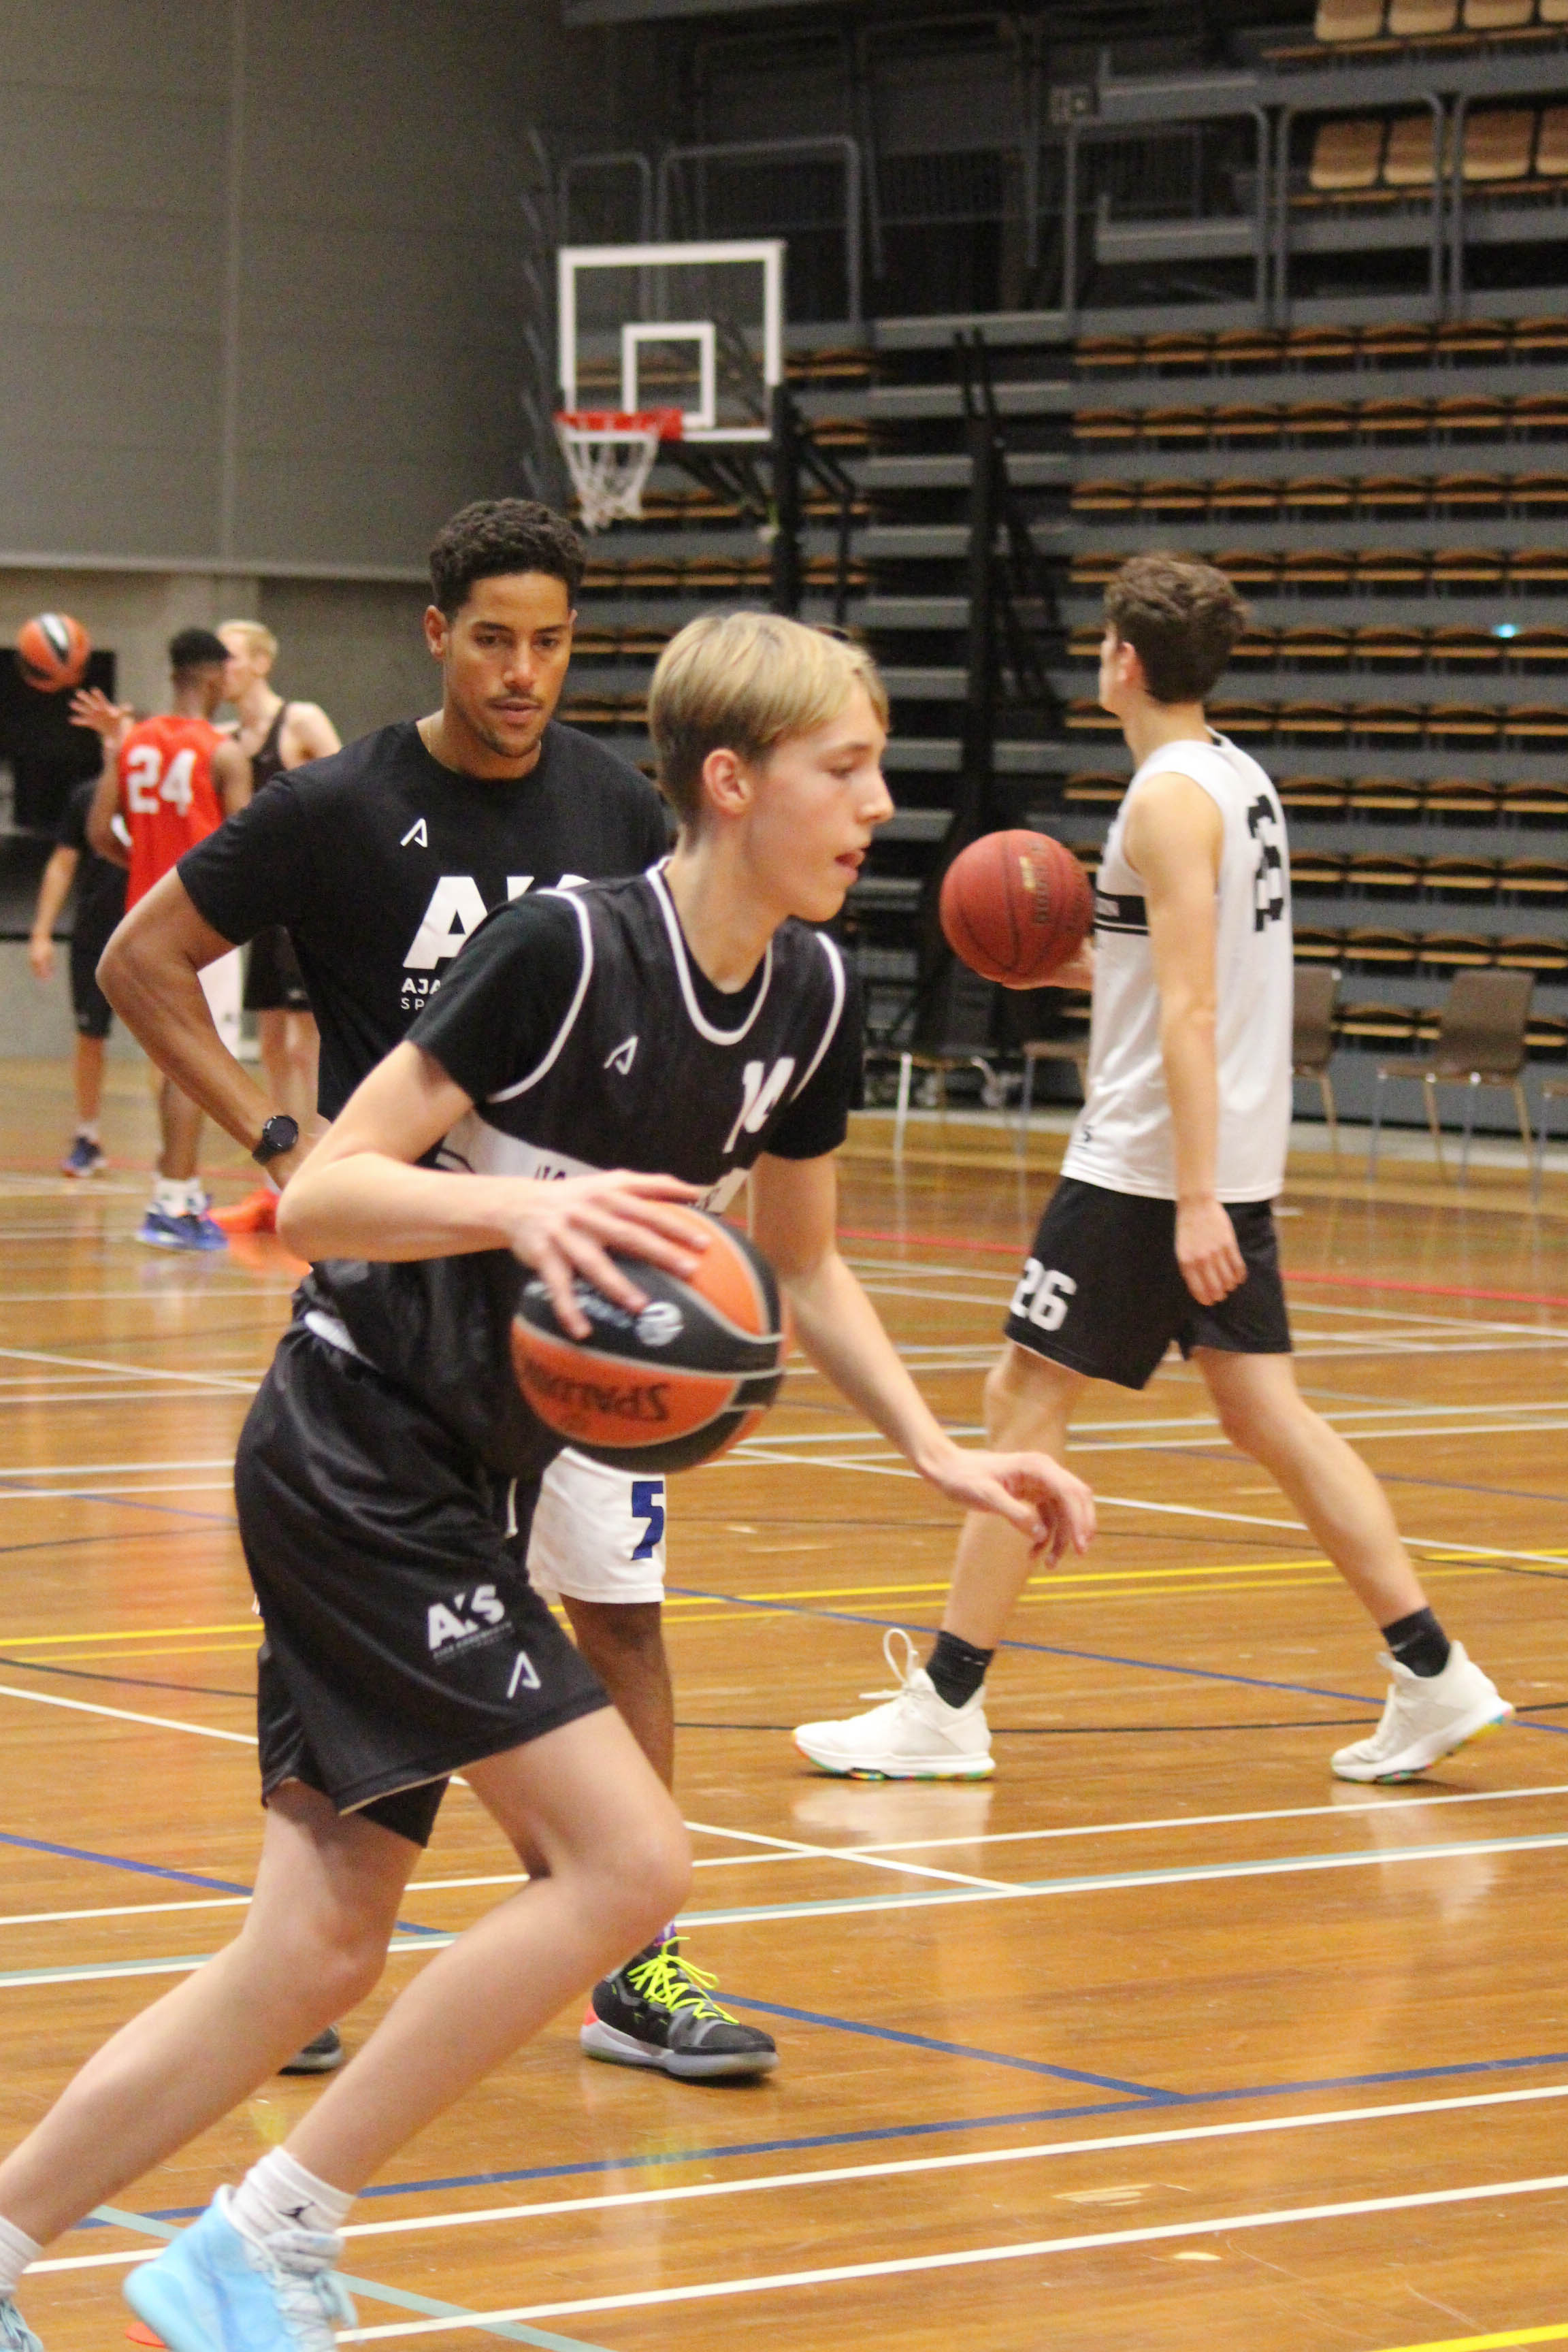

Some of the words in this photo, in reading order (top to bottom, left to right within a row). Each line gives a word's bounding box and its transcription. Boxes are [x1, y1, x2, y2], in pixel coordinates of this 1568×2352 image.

[127, 745, 197, 817] 24
[400, 998, 425, 1011] SP
[401, 977, 442, 994] AJA
[1010, 1257, 1077, 1332] 26
